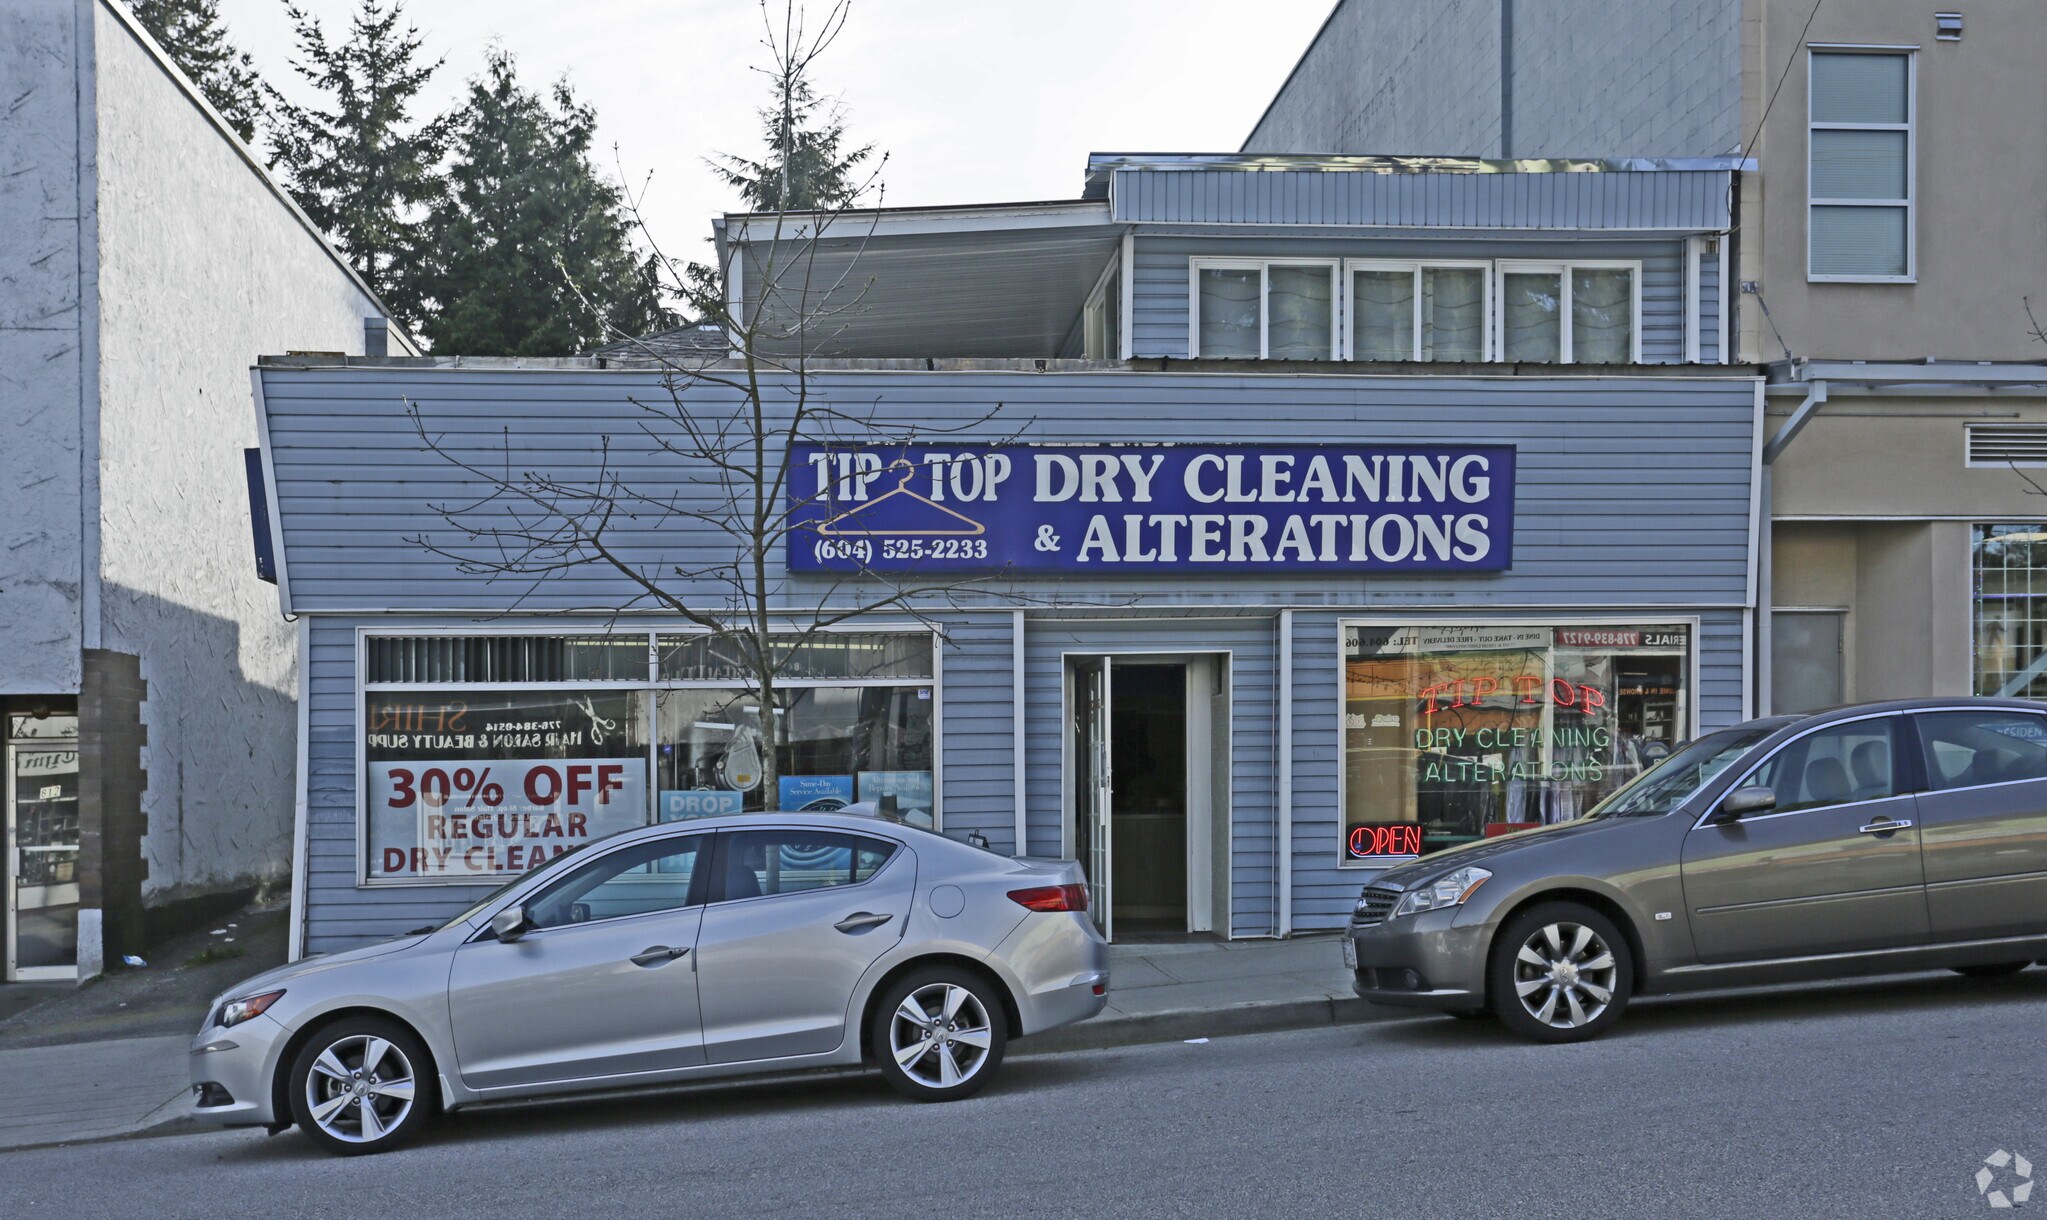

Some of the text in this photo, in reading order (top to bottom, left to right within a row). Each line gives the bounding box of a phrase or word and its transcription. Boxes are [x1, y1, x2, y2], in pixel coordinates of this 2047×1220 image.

[809, 453, 1490, 503] TIP TOP DRY CLEANING
[1034, 513, 1491, 562] & ALTERATIONS
[814, 540, 987, 565] (604) 525-2233
[1420, 676, 1605, 716] TIP TOP
[1416, 727, 1610, 749] DRY CLEANING
[800, 780, 831, 788] Same-Day
[1425, 762, 1603, 782] ALTERATIONS
[387, 765, 624, 808] 30% OFF
[814, 787, 842, 795] Available
[670, 796, 733, 813] DROP
[428, 813, 588, 840] REGULAR
[1350, 826, 1420, 855] OPEN
[383, 847, 452, 873] DRY
